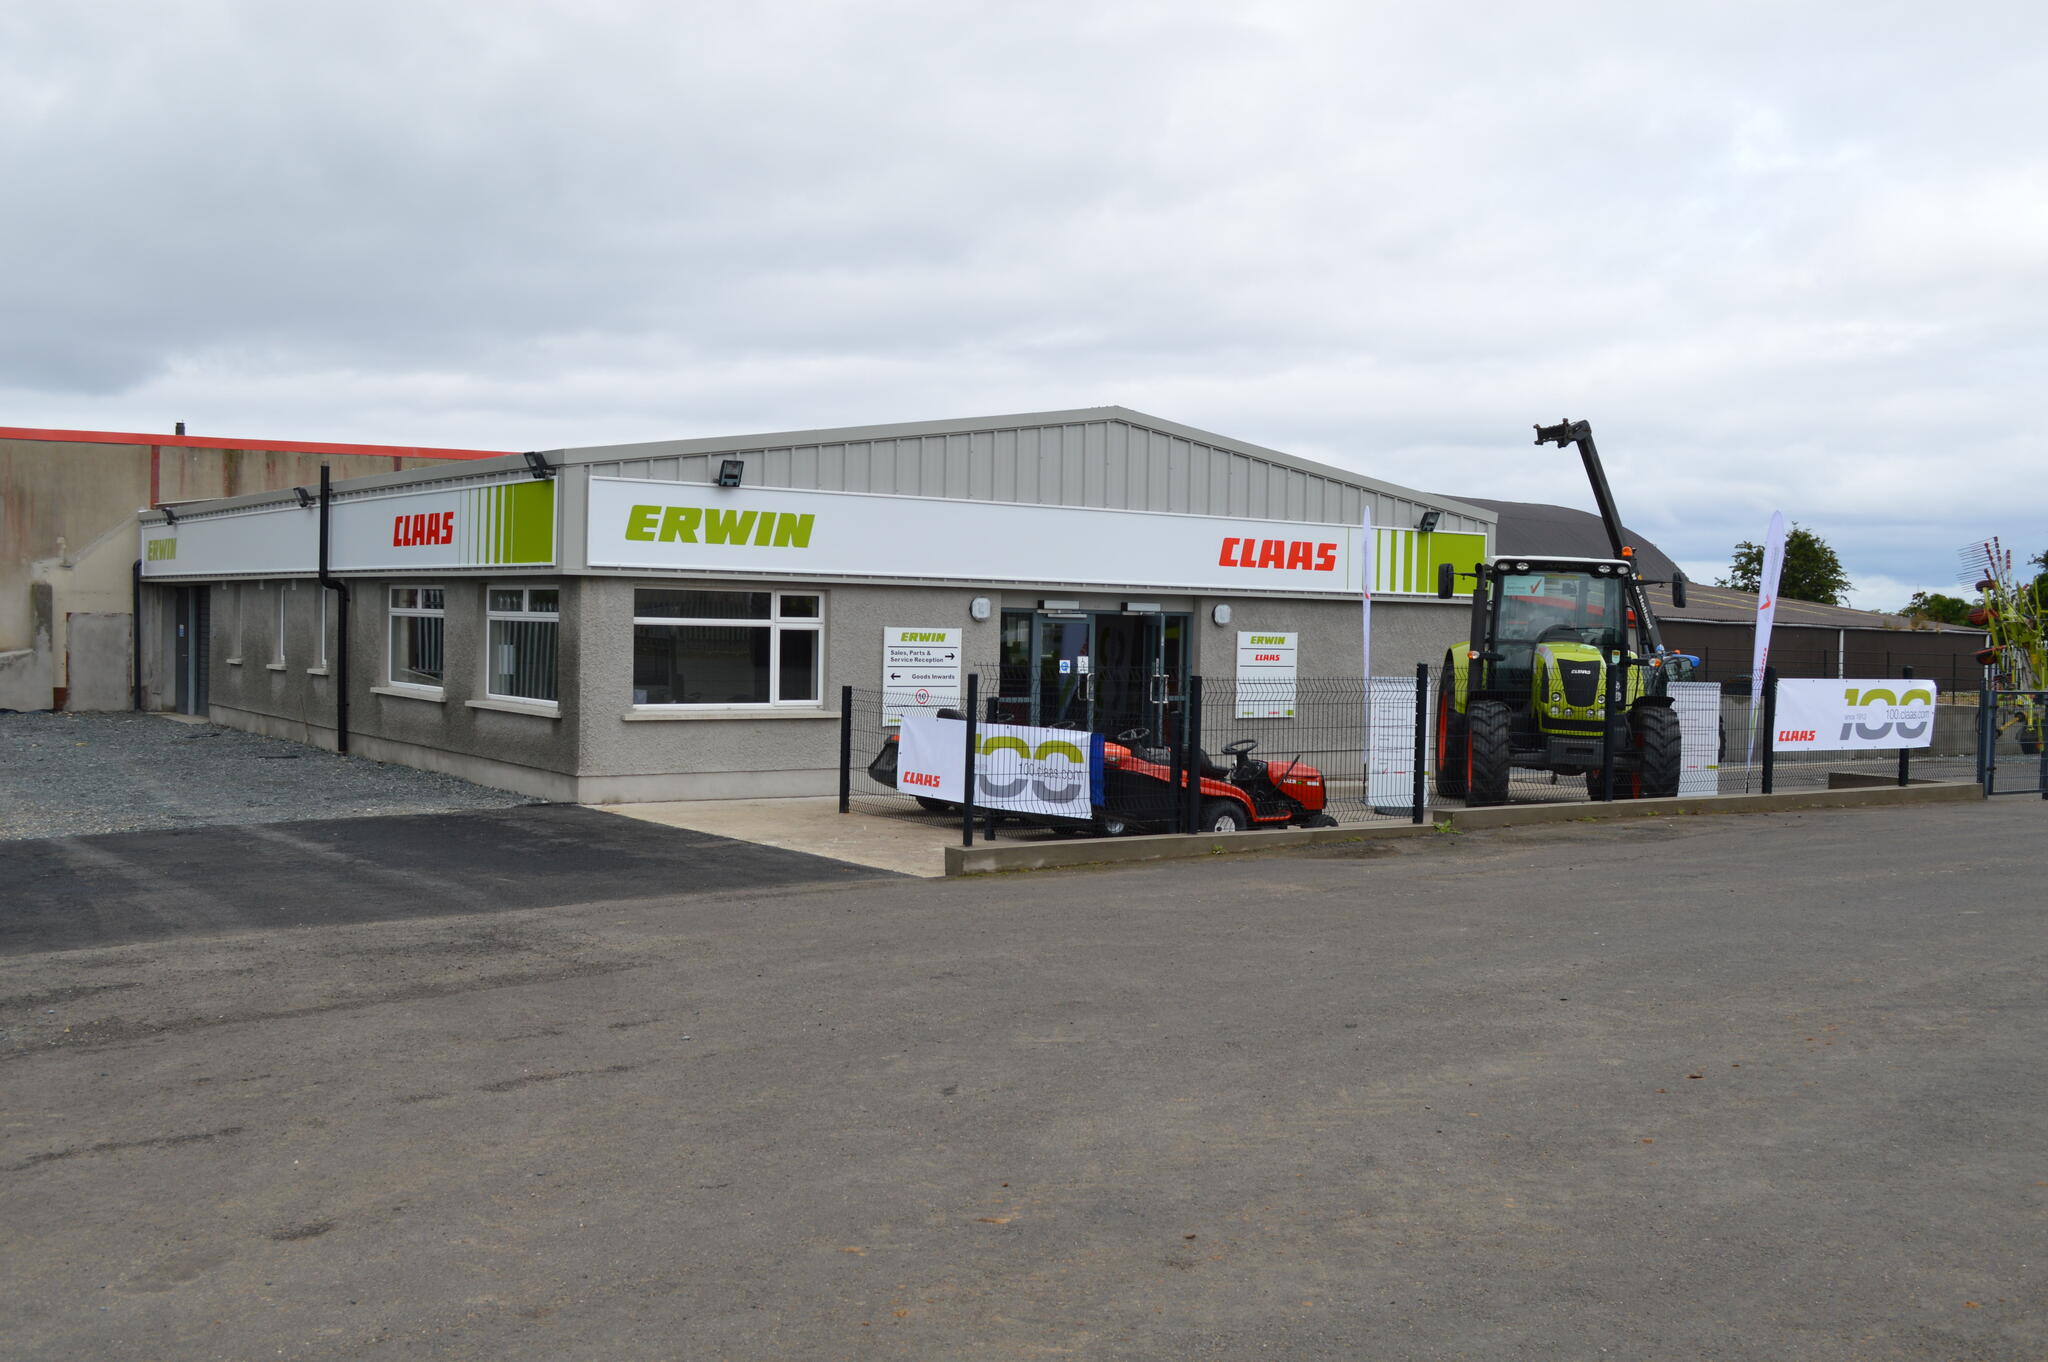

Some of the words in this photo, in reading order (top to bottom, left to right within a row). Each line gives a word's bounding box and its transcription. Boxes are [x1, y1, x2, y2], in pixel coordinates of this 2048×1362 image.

[393, 511, 454, 547] CLAAS
[625, 504, 815, 549] ERWIN
[146, 538, 177, 561] ERWIN
[1218, 536, 1338, 572] CLAAS
[901, 632, 947, 642] ERWIN
[1250, 635, 1286, 645] ERWIN
[1255, 654, 1281, 662] CLAAS
[1840, 688, 1932, 741] 100
[1778, 730, 1817, 742] CLAAS
[902, 770, 941, 788] CLAAS
